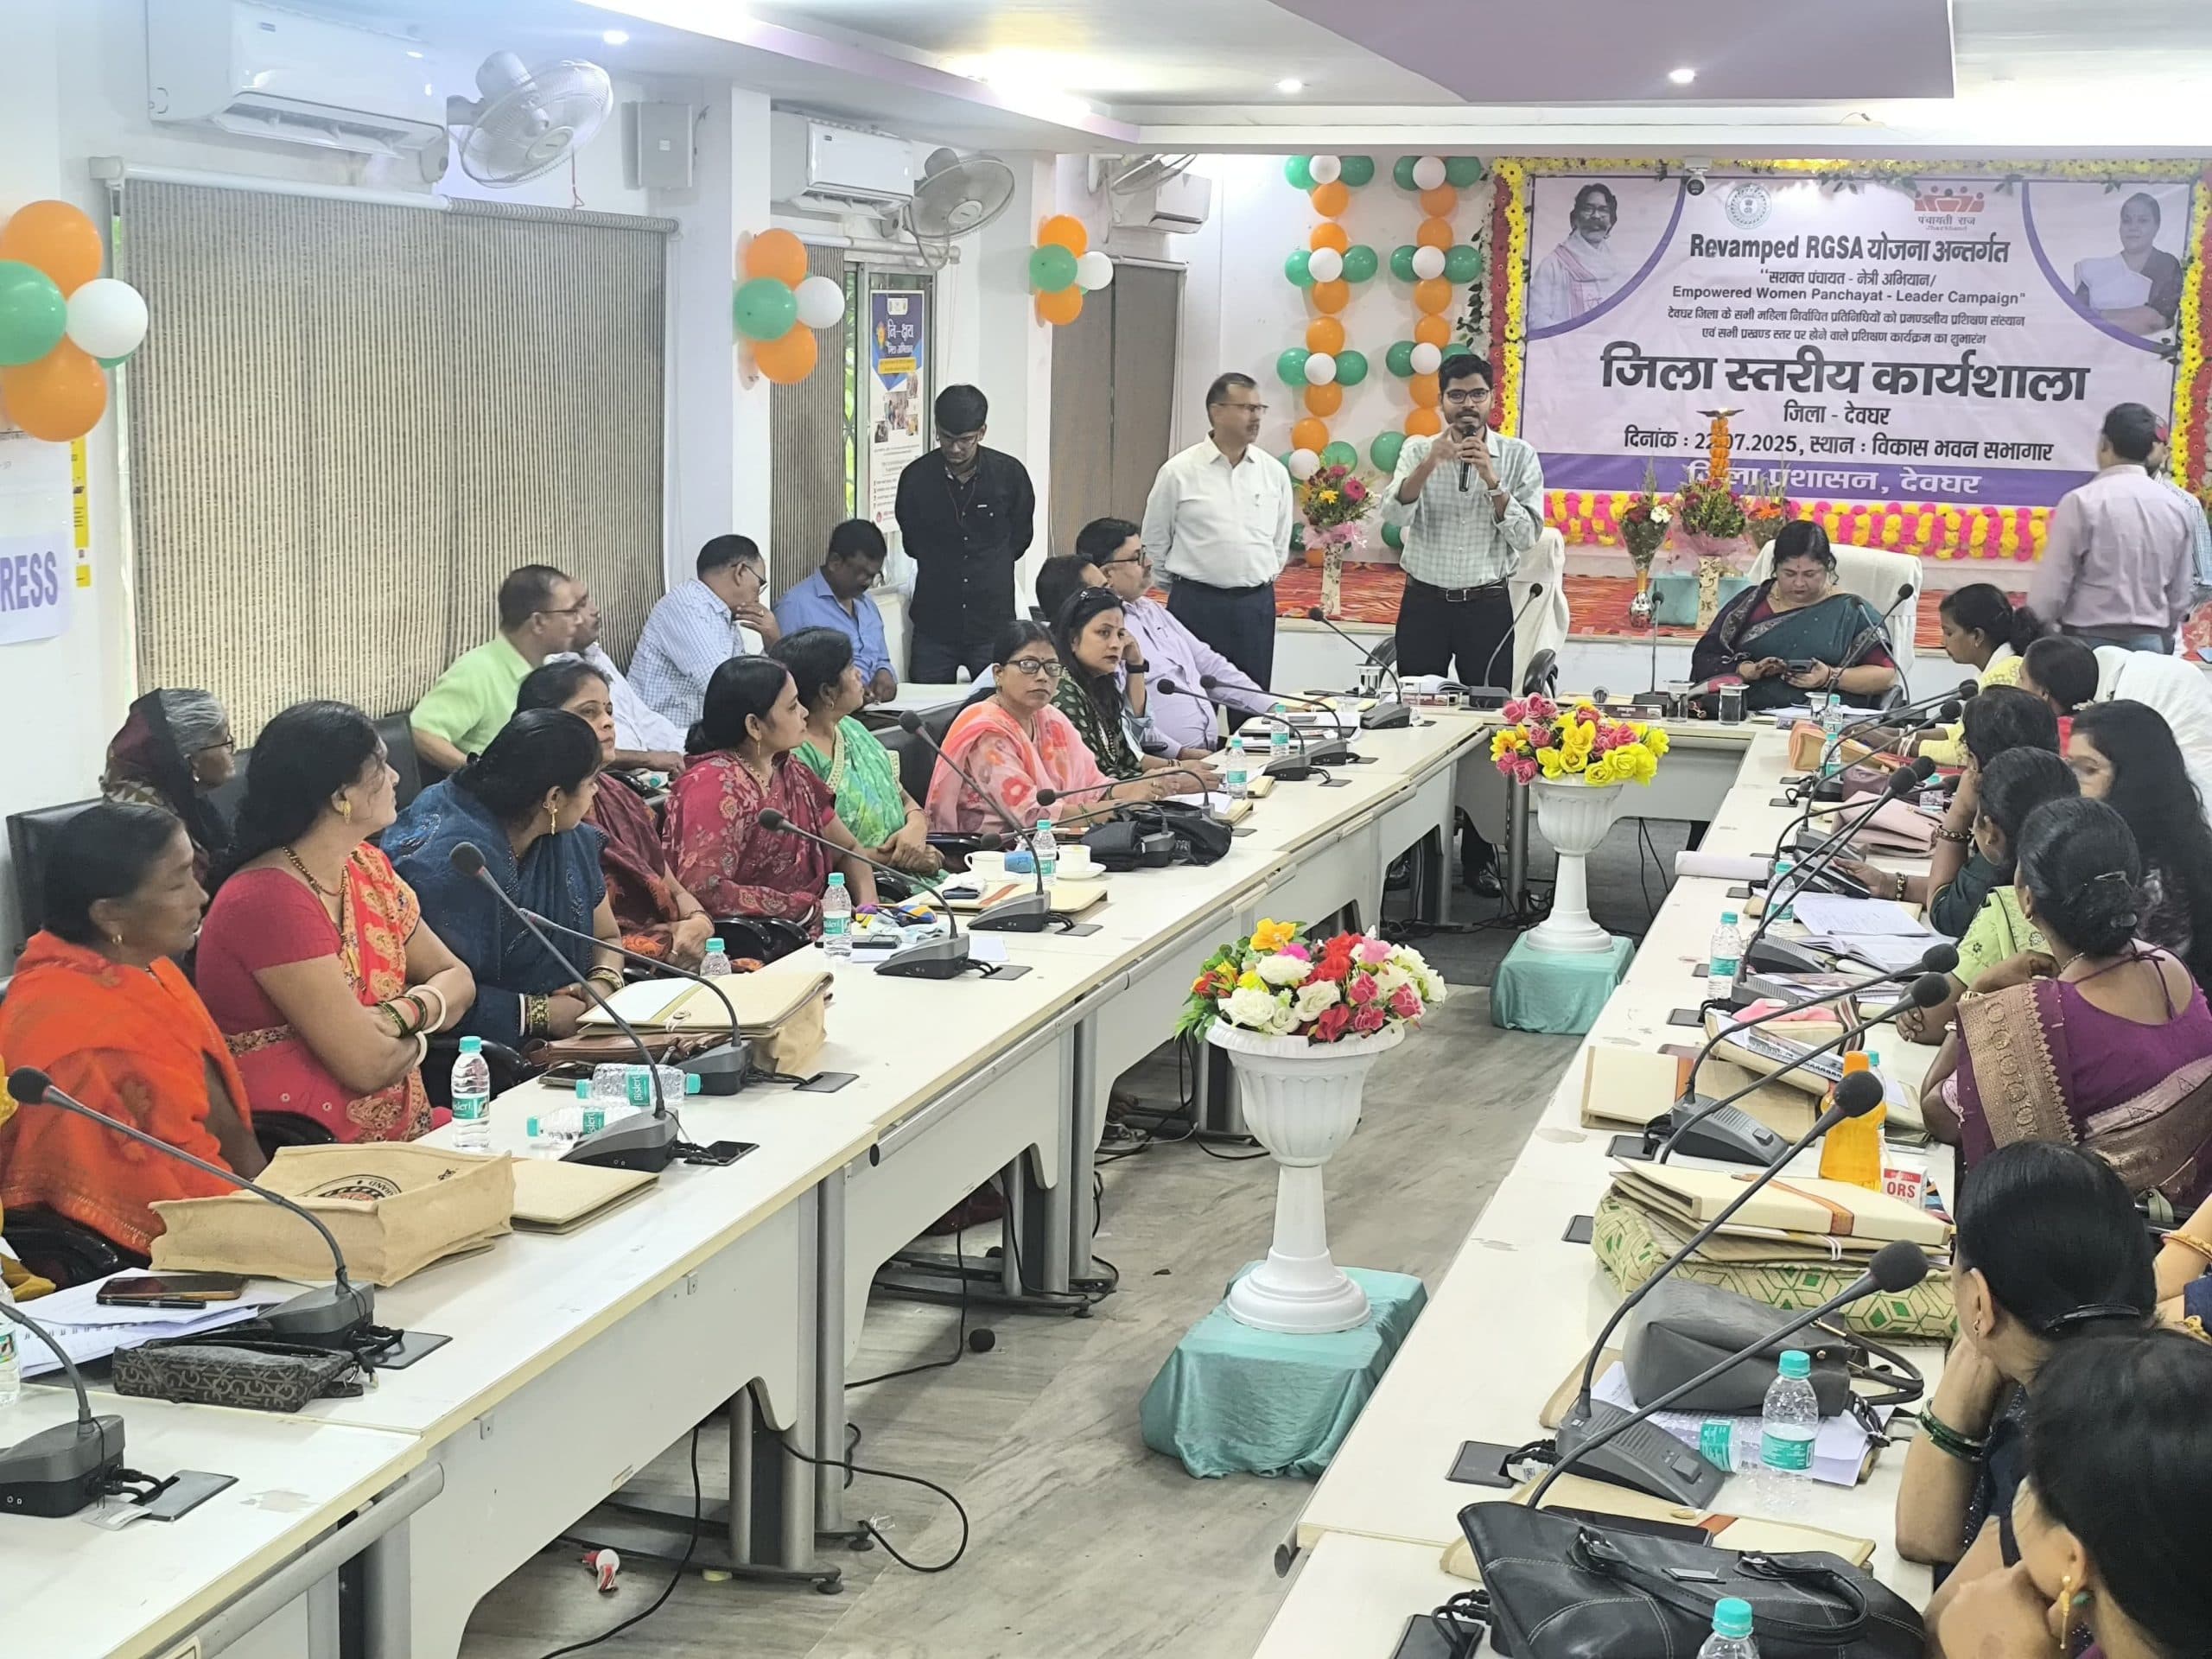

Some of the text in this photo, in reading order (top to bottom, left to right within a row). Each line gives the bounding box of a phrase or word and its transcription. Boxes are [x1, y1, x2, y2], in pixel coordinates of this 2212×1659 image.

[1918, 214, 1976, 226] पंचायती राज
[1690, 232, 2011, 264] Revamped RGSA योजना अन्तर्गत
[1808, 270, 1846, 285] पंचायत
[1857, 269, 1878, 286] नेत्री
[1882, 270, 1937, 287] अभियान/
[1673, 286, 1752, 300] Empowered
[1757, 288, 1807, 299] Women
[1812, 289, 1884, 303] Panchayat
[1897, 289, 1944, 302] Leader
[1948, 290, 2025, 307] Campaign"
[1668, 306, 1693, 319] देवघर
[1695, 307, 1719, 320] जिला
[1721, 307, 1731, 320] के
[1734, 308, 1754, 321] सभी
[1758, 308, 1787, 321] महिला
[1789, 308, 1827, 322] निर्वाचित
[1831, 308, 1881, 323] प्रतिनिधियों
[1884, 310, 1897, 324] को
[1951, 312, 1987, 326] प्रशिक्षण
[1990, 314, 2025, 327] संस्थान
[1702, 326, 1986, 346] एवं सभी प्रखण्ड स्तर पर होने वाले प्रशिक्षण कार्यक्रम का शुभारंभ
[1600, 340, 2091, 402] जिला स्तरीय कार्यशाला
[1783, 399, 1826, 424] जिला
[1844, 400, 1891, 426] देवघर
[1624, 424, 1679, 448] दिनांक
[1809, 435, 1856, 456] स्थान
[1872, 434, 1929, 456] विकास
[1935, 439, 1979, 459] भवन
[1983, 441, 2054, 462] सभागार
[1899, 466, 1982, 494] देवघर
[1887, 1181, 1916, 1198] ORS
